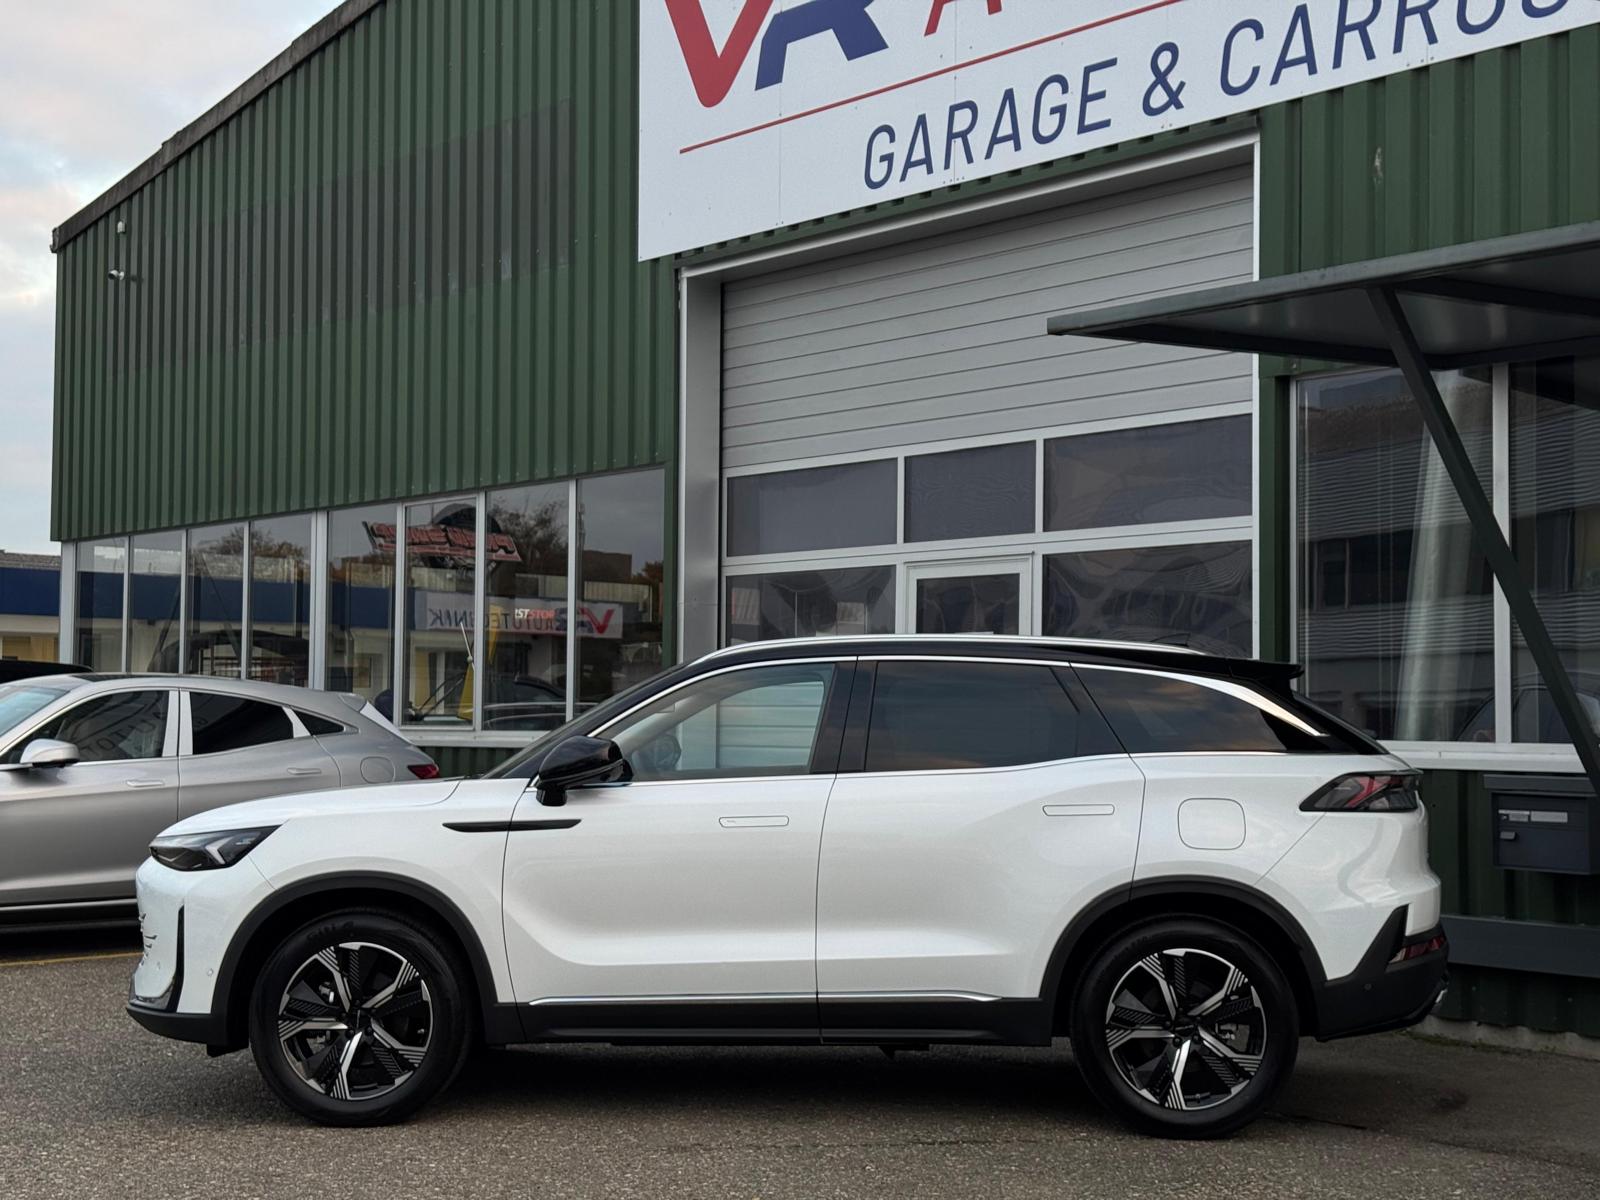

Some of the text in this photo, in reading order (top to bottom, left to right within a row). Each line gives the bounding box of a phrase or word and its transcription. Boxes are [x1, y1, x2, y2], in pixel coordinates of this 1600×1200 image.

[863, 0, 1569, 190] GARAGE & CARR
